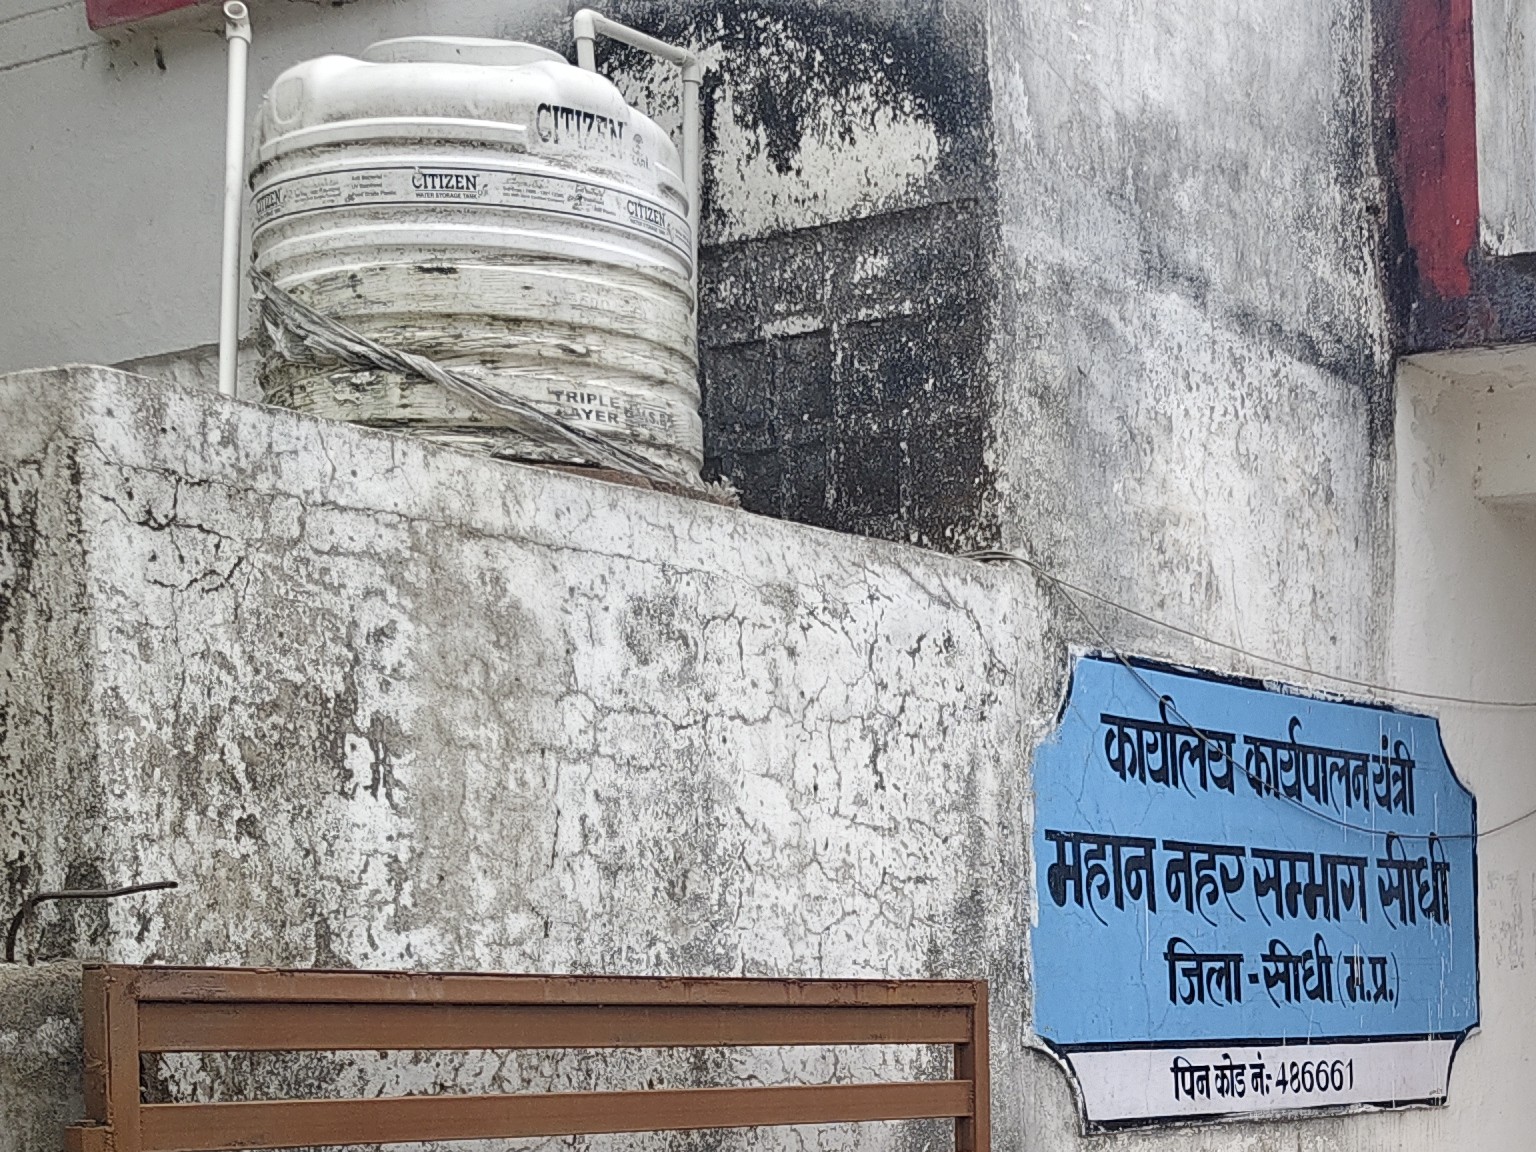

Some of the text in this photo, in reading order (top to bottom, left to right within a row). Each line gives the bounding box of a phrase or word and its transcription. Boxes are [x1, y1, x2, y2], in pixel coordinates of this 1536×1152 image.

[536, 102, 624, 158] CITIZEN
[412, 173, 477, 190] CITIZEN
[627, 200, 666, 227] CITIZEN
[552, 391, 620, 408] TRIPLE
[1100, 695, 1236, 799] कार्यालय
[1045, 829, 1157, 927] महान
[1162, 839, 1247, 927] नहर
[1251, 847, 1368, 926] सम्भाग
[1377, 832, 1450, 931] सीधी
[1163, 936, 1244, 1007] जिला
[1170, 1056, 1211, 1101] पिन
[1213, 1053, 1247, 1098] कोड
[1275, 1058, 1353, 1095] 486661
